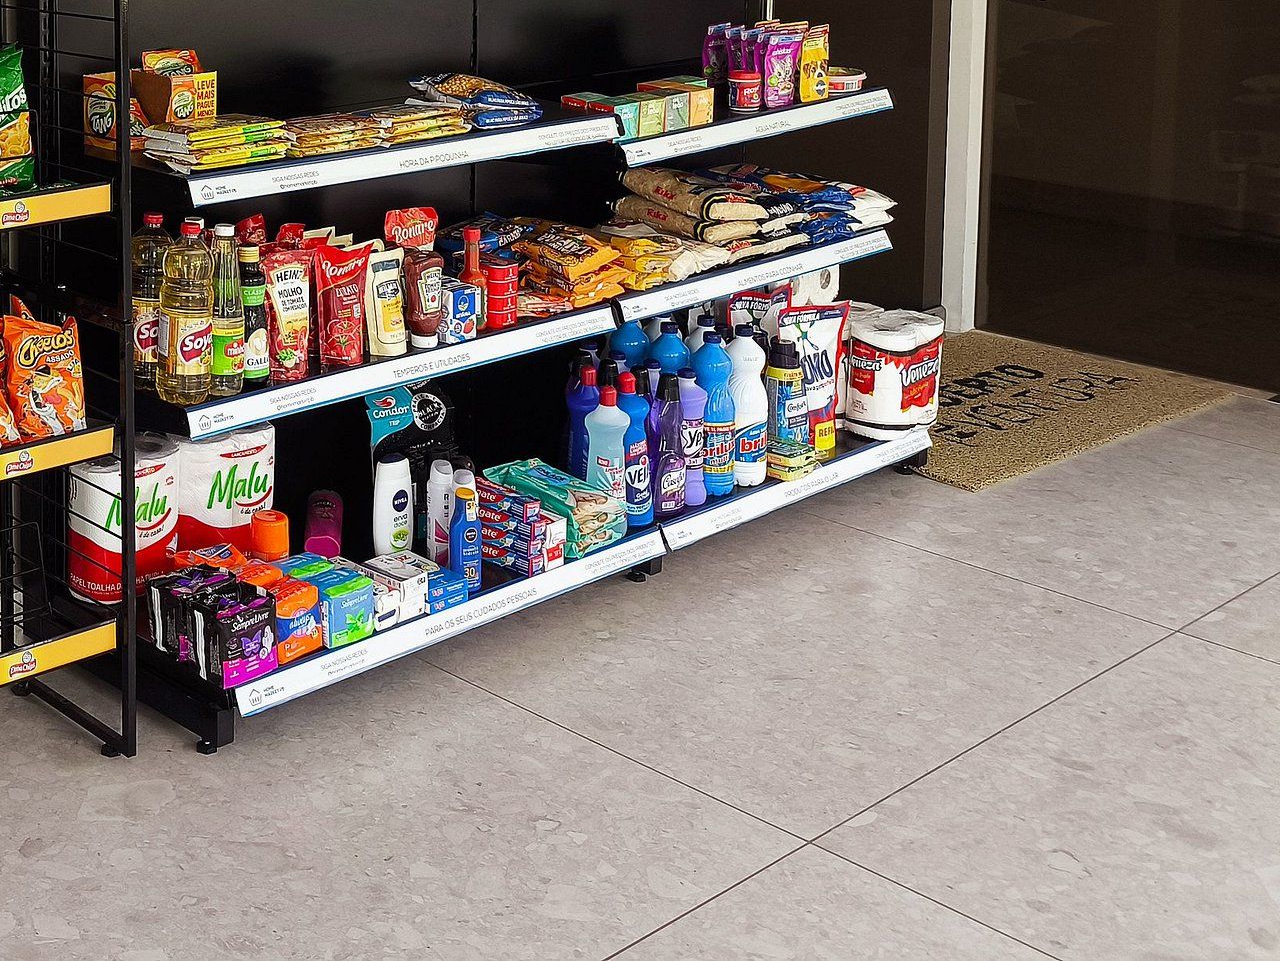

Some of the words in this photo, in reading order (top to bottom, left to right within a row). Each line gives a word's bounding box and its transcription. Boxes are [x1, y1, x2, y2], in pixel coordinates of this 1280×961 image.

[197, 79, 215, 90] LEVE
[196, 90, 215, 100] MAIS
[174, 103, 194, 118] TANG
[196, 100, 215, 109] PAGUE
[196, 109, 215, 118] MENOS
[90, 115, 113, 133] TANG
[399, 157, 419, 169] HORA
[275, 268, 305, 282] HEINZ
[278, 287, 303, 299] MOLHO
[18, 328, 74, 368] Cheetos
[45, 350, 75, 363] ASSADO
[393, 362, 429, 378] TEMPEROS
[434, 352, 471, 368] UTILIDADES
[801, 349, 833, 385] OMO
[900, 357, 939, 387] Veneza
[373, 406, 410, 420] Condor
[740, 431, 767, 453] bril
[207, 461, 270, 510] Malu
[464, 567, 475, 578] 30
[425, 620, 444, 636] PARA
[455, 610, 473, 625] SEUS
[472, 598, 506, 621] CUIDADOS
[506, 587, 538, 608] PESSOAIS
